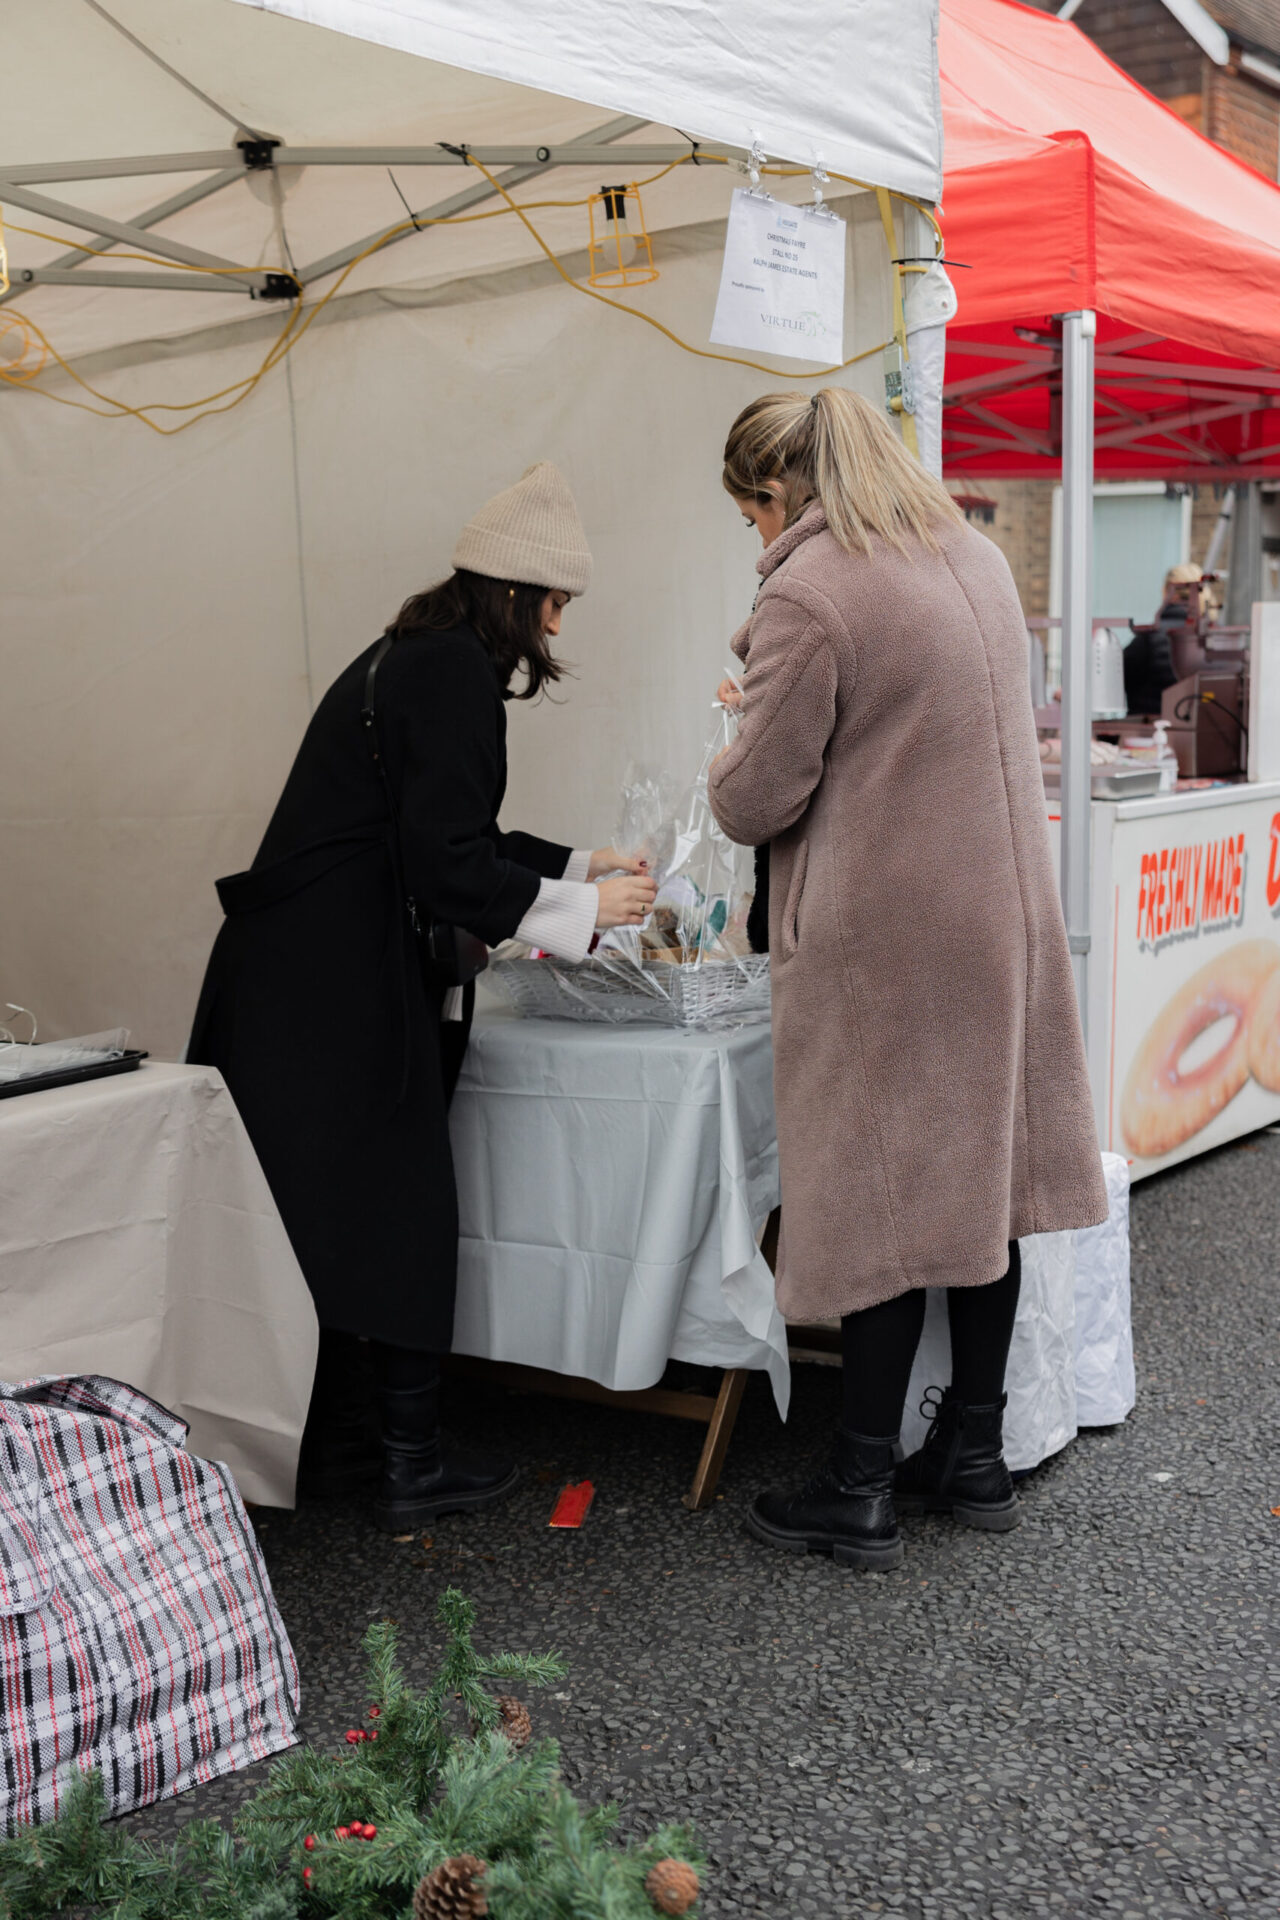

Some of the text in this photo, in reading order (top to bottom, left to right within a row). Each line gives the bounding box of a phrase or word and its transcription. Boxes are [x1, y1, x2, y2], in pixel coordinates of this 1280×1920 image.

[781, 265, 798, 275] ESTATE
[798, 269, 818, 280] AGENTS
[760, 313, 806, 331] VIRTUE
[1137, 844, 1203, 942] FRESHLY
[1202, 832, 1245, 923] MADE
